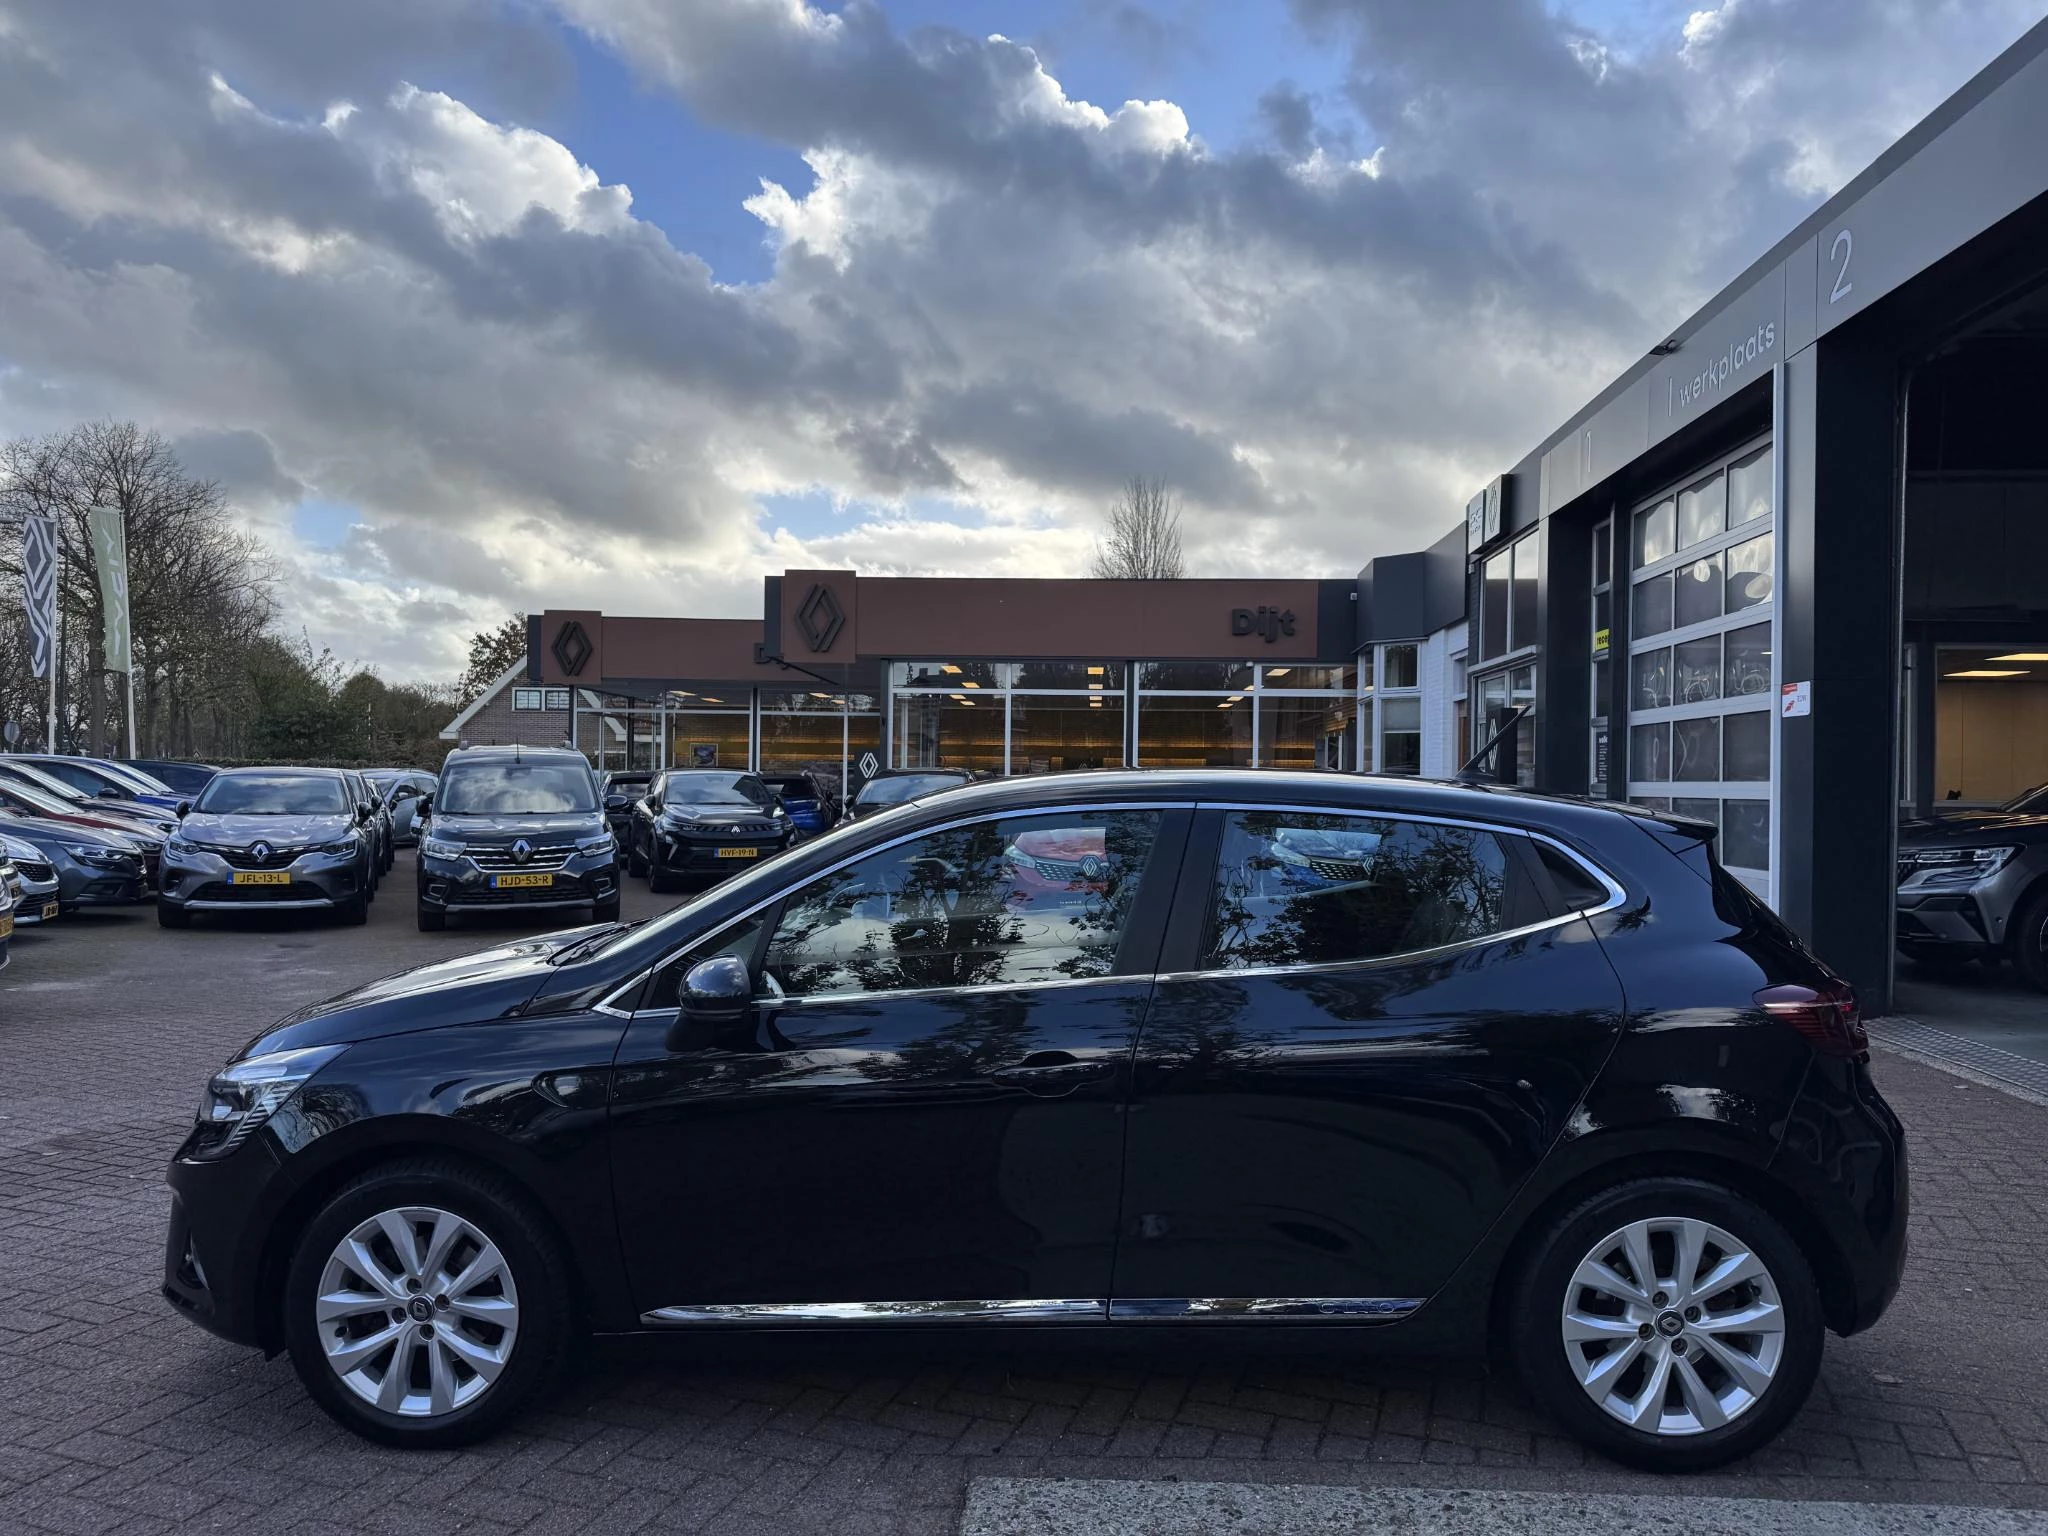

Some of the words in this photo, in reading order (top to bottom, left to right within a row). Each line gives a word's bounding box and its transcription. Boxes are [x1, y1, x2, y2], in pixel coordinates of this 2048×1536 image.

[1829, 229, 1852, 304] 2
[1679, 321, 1775, 408] werkplaats
[1231, 605, 1296, 643] Dijt
[239, 873, 283, 883] JFL-13-L
[500, 875, 549, 886] HJD-53-R
